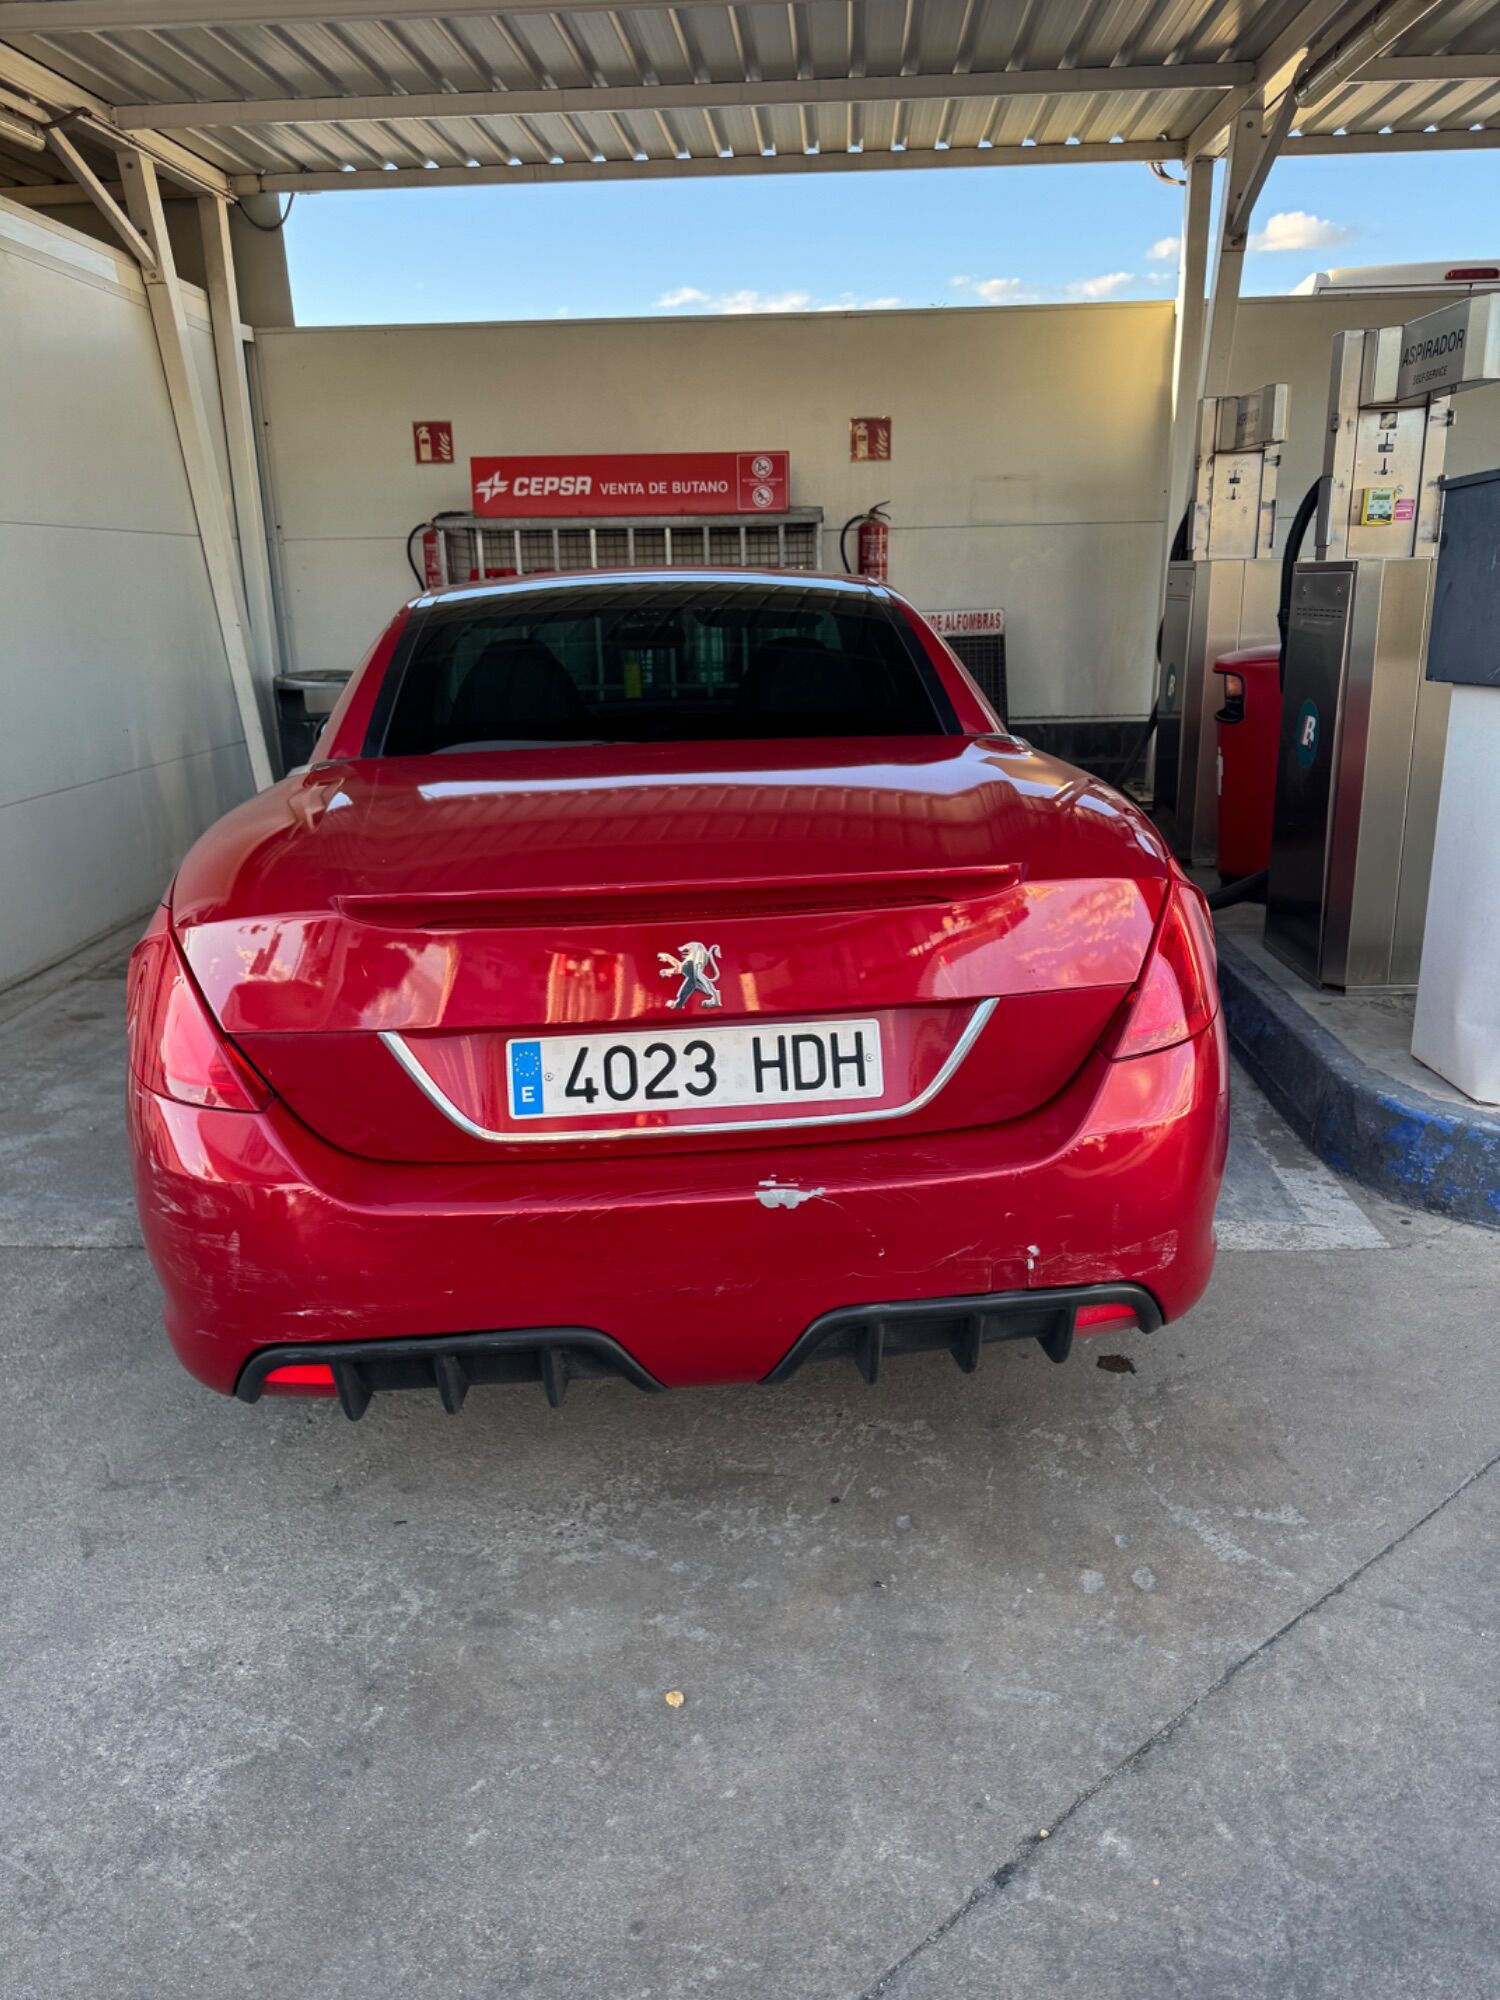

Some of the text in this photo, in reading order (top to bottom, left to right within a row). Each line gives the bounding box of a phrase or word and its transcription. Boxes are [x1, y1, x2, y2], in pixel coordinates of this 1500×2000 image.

[1402, 328, 1465, 368] ASPIRADOR
[513, 476, 592, 496] CEPSA
[600, 482, 645, 495] VENTA
[649, 482, 667, 494] DE
[672, 480, 729, 494] BUTANO
[944, 612, 1001, 632] ALFOMBRAS
[565, 1031, 866, 1104] 4023 HDH
[522, 1086, 534, 1103] E
